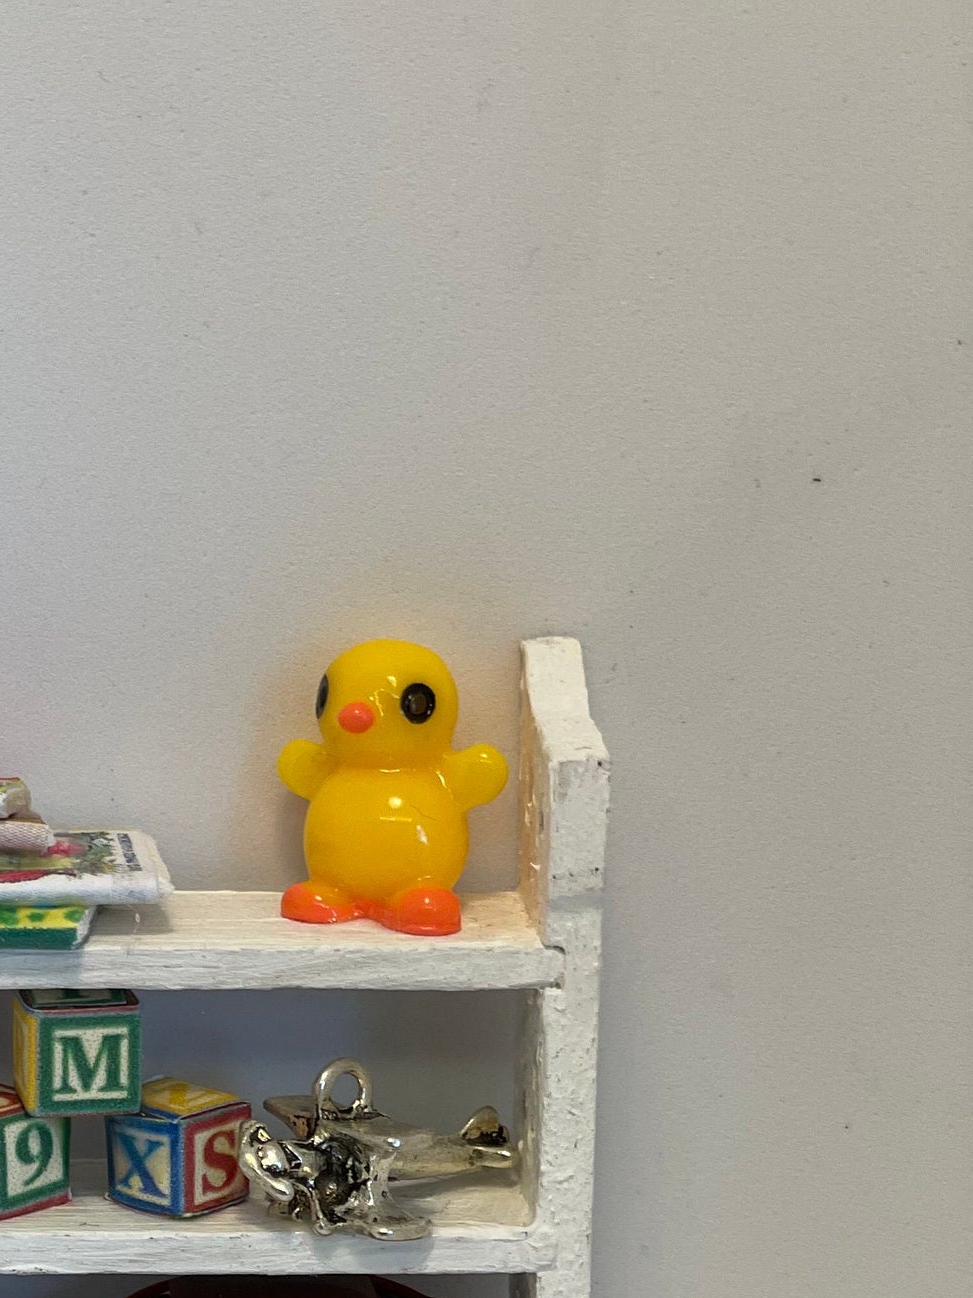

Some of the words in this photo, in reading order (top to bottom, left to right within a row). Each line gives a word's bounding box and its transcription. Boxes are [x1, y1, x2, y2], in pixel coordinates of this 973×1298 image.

[54, 1034, 127, 1095] M
[14, 1121, 54, 1187] 9
[115, 1129, 169, 1198] X
[201, 1130, 239, 1196] S
